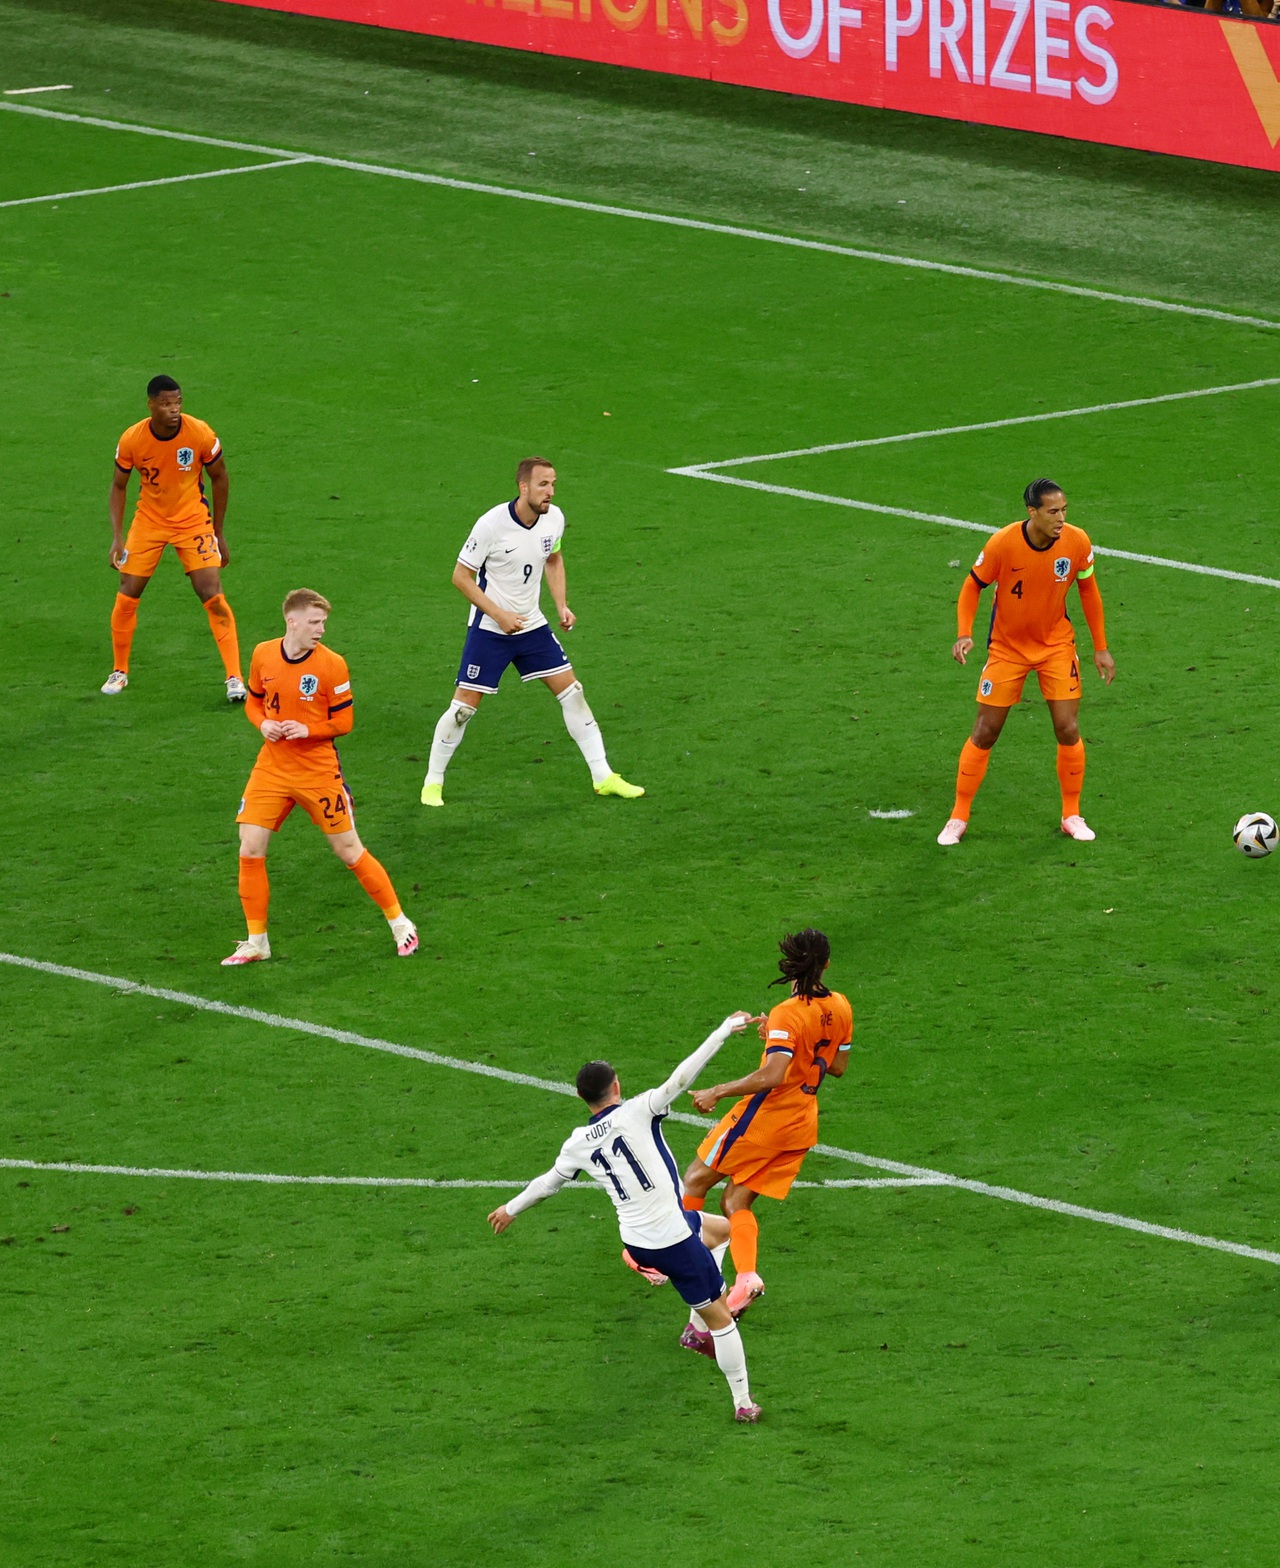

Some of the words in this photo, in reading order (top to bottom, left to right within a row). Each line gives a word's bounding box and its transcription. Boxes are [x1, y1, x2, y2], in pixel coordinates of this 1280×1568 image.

[766, 0, 862, 63] OF
[884, 0, 1120, 105] PRIZES
[193, 534, 217, 555] 22
[523, 564, 533, 585] 9
[1010, 580, 1023, 600] 4
[1069, 660, 1079, 682] 4
[319, 793, 347, 819] 24
[800, 1038, 832, 1096] 5
[591, 1134, 656, 1203] 11
